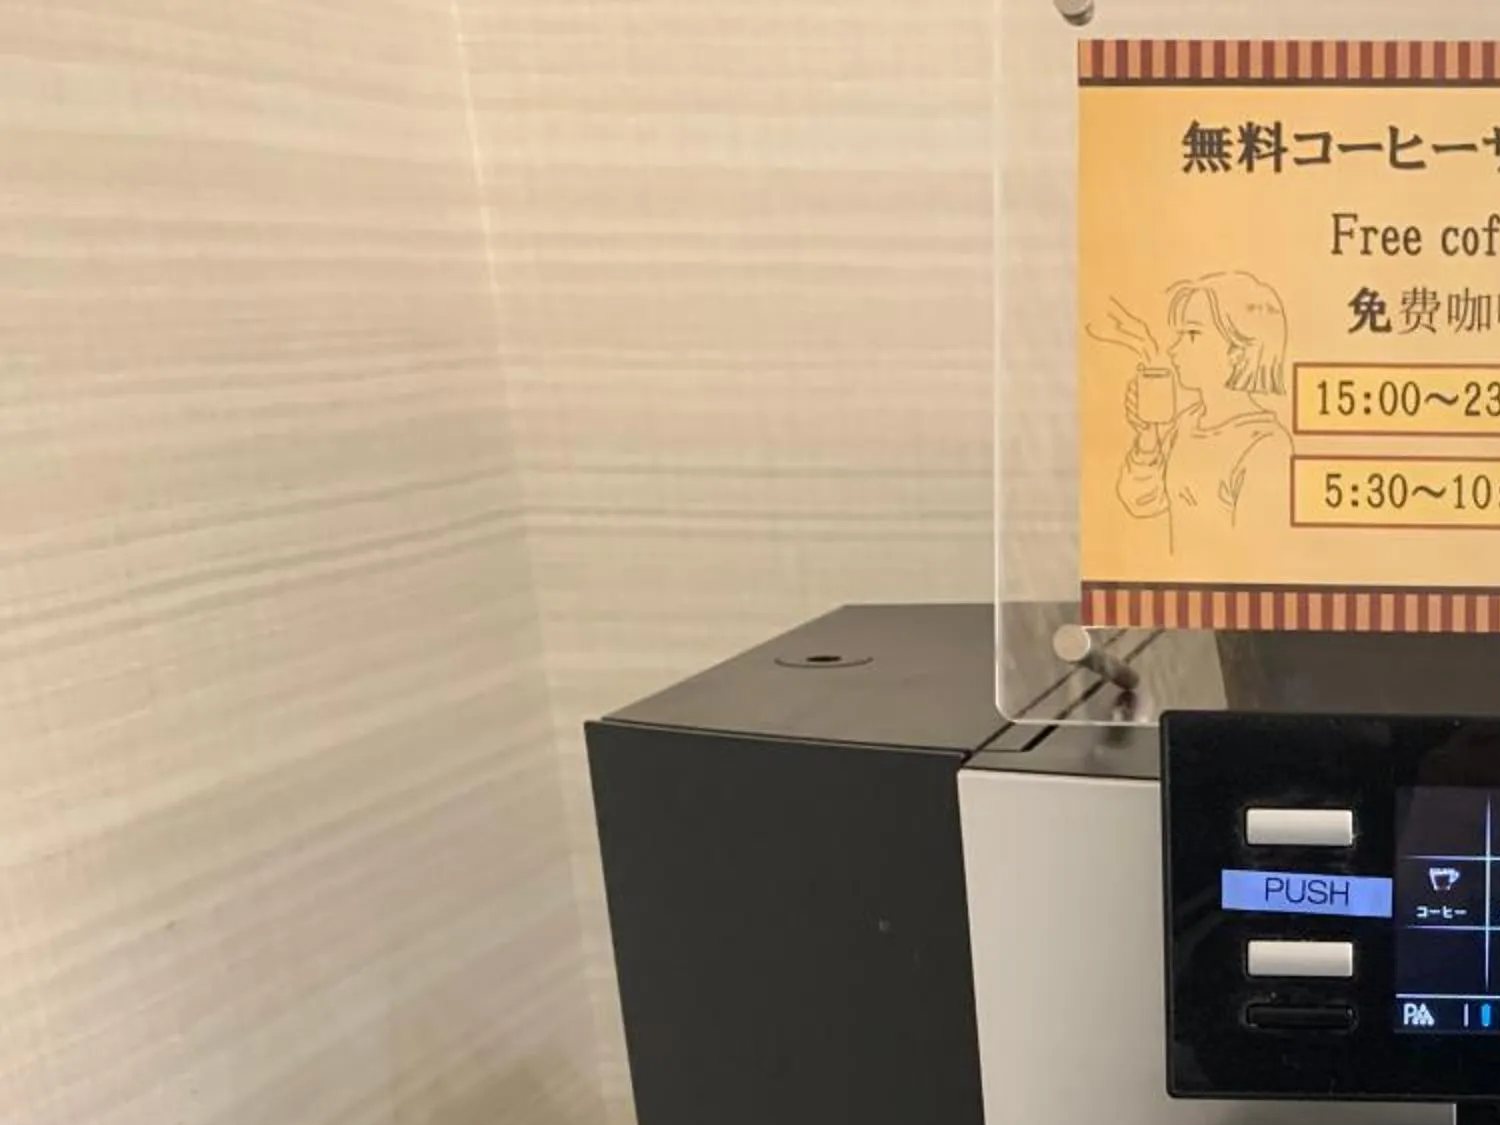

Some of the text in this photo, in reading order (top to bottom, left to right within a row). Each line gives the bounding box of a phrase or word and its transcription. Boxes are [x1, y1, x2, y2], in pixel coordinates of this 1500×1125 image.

[1331, 213, 1423, 258] Free
[1264, 876, 1350, 907] PUSH
[1415, 905, 1468, 920] コーヒー
